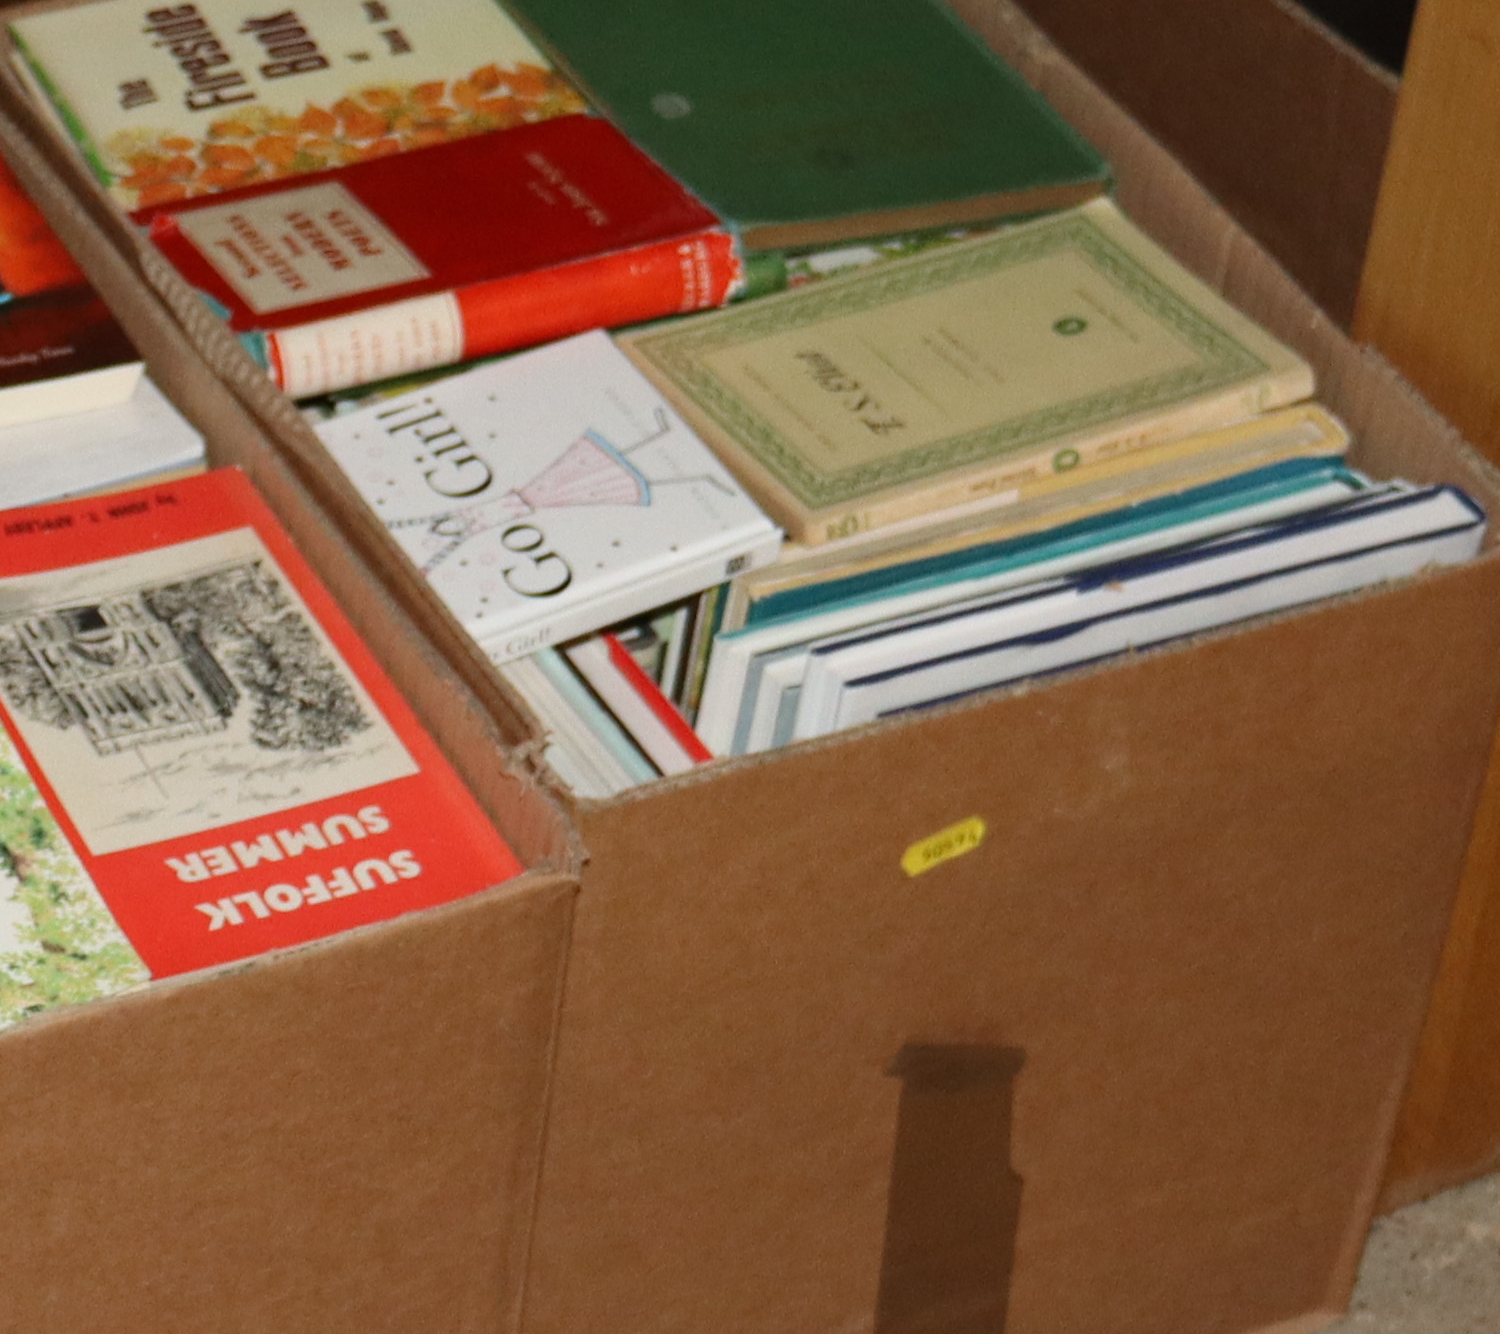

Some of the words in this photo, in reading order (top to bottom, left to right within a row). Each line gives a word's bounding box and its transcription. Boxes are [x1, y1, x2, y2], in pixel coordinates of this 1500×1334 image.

[143, 2, 257, 113] Fireside
[238, 9, 331, 81] Book
[118, 78, 159, 111] The
[500, 522, 573, 599] Go
[164, 805, 391, 884] SUMMER
[194, 849, 423, 932] SUFFOLK
